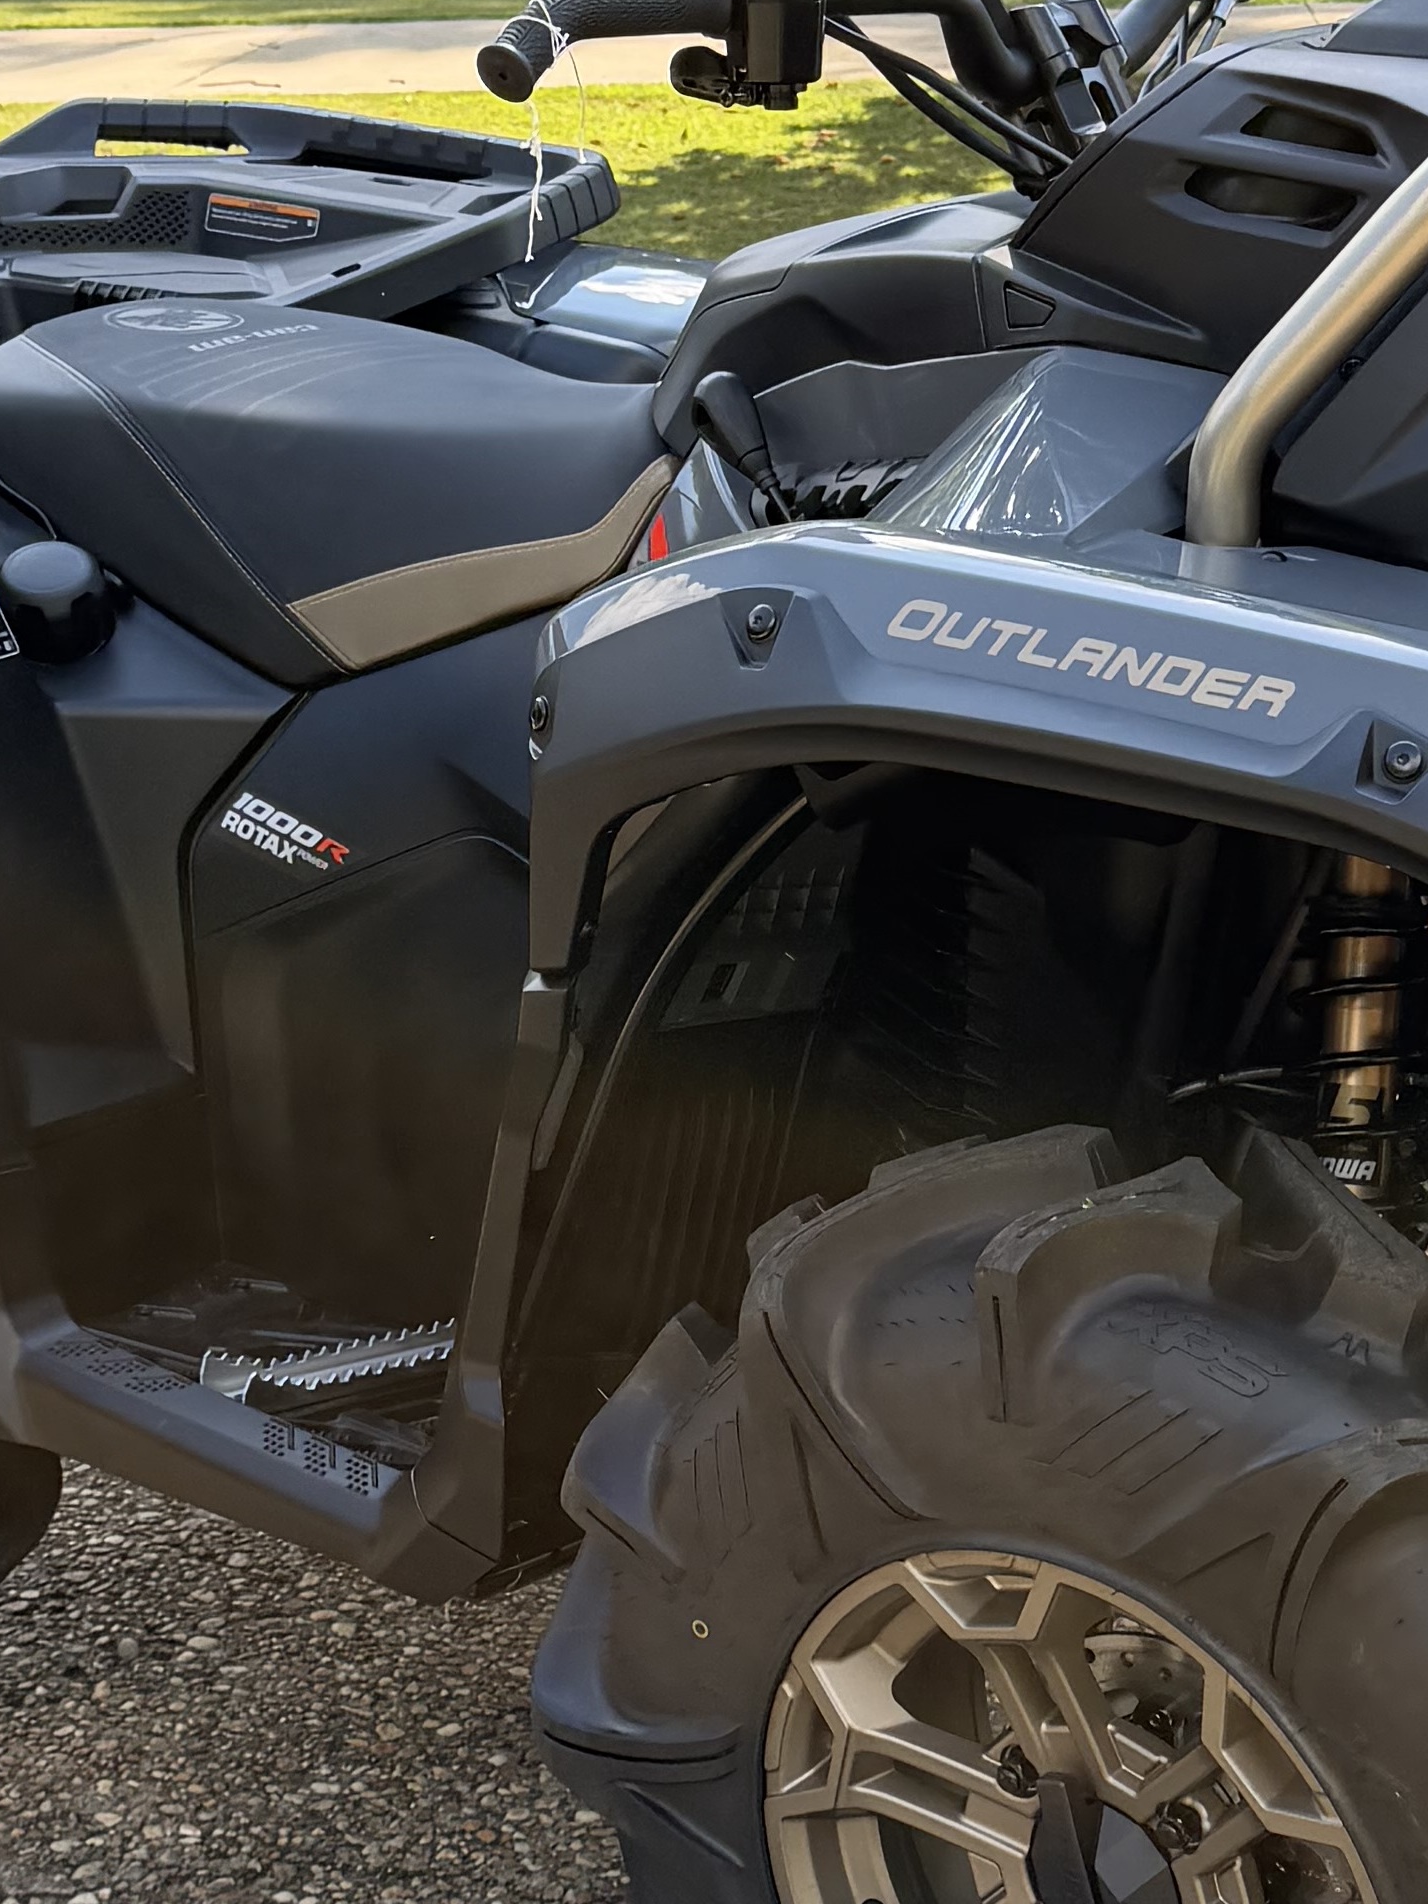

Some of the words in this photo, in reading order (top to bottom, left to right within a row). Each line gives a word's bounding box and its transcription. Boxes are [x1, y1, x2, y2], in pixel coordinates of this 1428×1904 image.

[887, 599, 1296, 718] OUTLANDER
[221, 810, 299, 865] ROTAX
[232, 792, 350, 865] 1000R
[1319, 1157, 1377, 1181] OWA
